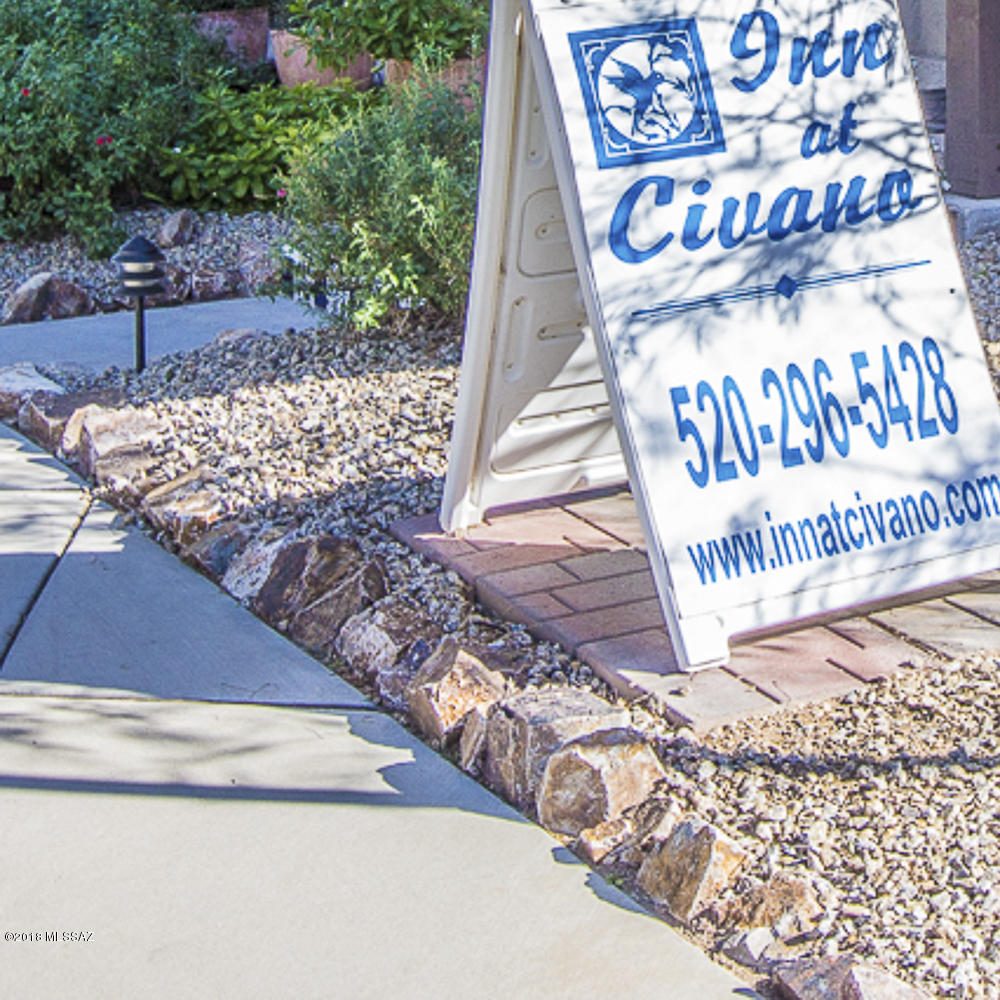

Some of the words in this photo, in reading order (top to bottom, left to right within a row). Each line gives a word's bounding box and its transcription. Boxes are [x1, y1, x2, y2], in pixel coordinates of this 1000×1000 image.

[730, 9, 891, 92] Inn
[800, 101, 860, 160] at
[608, 168, 922, 264] Civano
[670, 337, 959, 489] 520-296-5428
